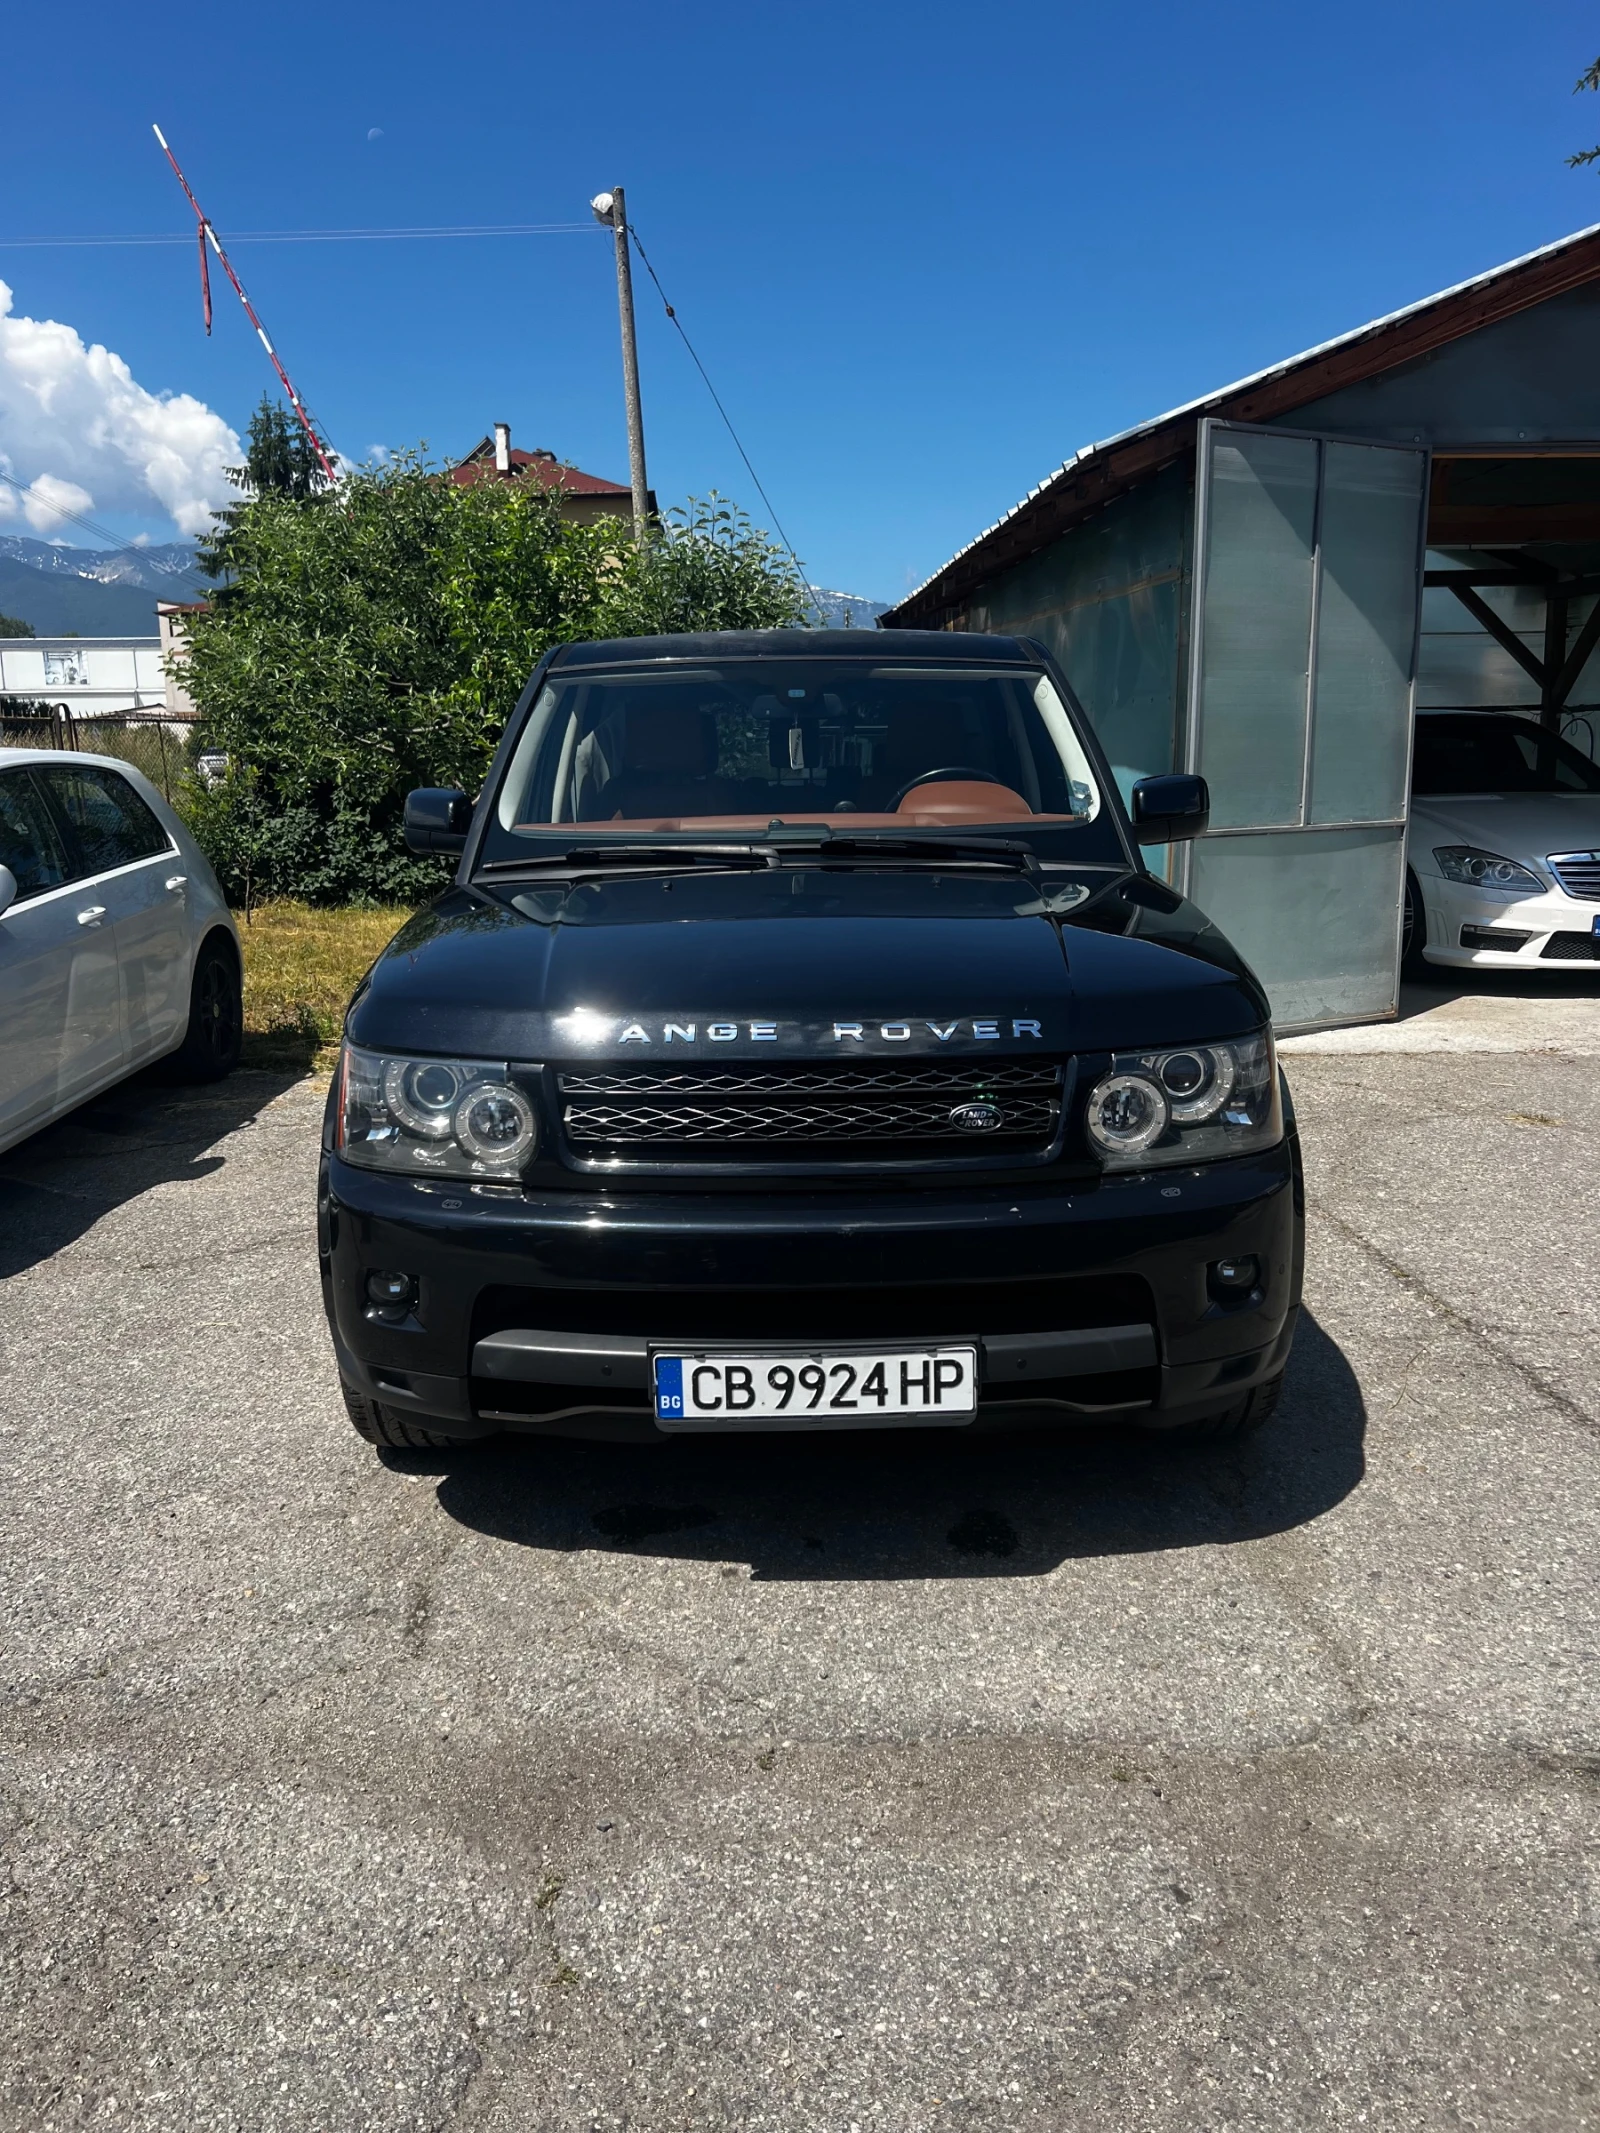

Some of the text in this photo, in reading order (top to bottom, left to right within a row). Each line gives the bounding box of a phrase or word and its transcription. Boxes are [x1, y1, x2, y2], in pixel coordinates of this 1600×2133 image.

[574, 1019, 1043, 1044] ANGE ROVER
[767, 1361, 889, 1410] 9924
[660, 1395, 681, 1409] BG
